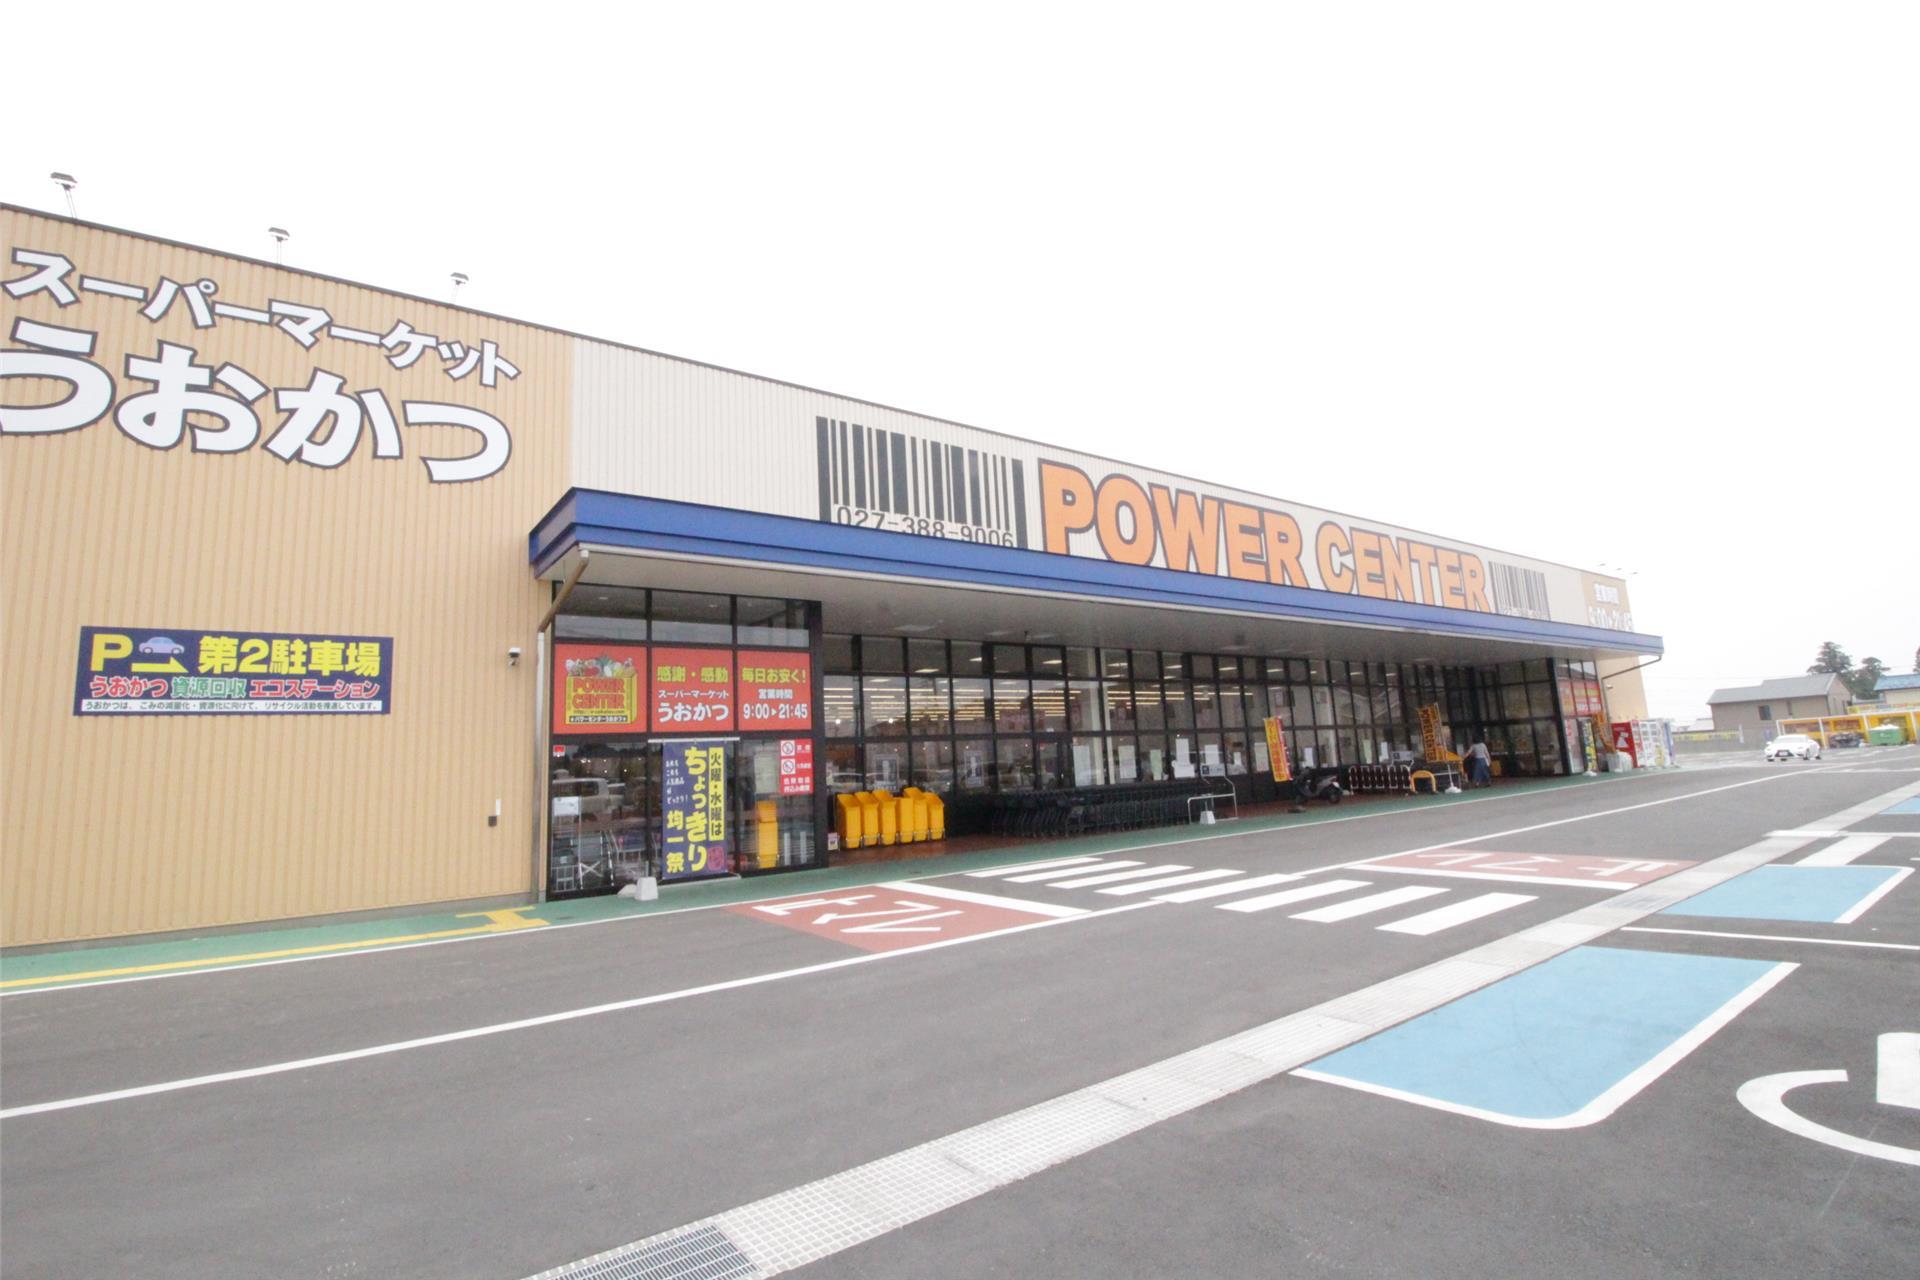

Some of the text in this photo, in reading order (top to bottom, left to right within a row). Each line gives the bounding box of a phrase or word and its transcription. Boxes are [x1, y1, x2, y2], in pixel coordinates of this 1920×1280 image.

[2, 246, 521, 387] スーパーマーケット
[0, 316, 512, 483] うおかつ
[837, 506, 1014, 547] 027-388-9006
[1038, 458, 1491, 613] POWER CENTER
[90, 634, 381, 677] P 第2駐車場
[657, 666, 729, 683] 感謝・感動
[90, 675, 381, 699] うおかつ 資源回収 エコステーション
[658, 689, 729, 699] スーパーマーケット
[758, 688, 793, 699] 営業時間
[658, 702, 729, 723] うおかつ
[684, 746, 708, 872] ちょっきり
[710, 752, 722, 837] 火曜・水曜は
[666, 810, 684, 873] 均一祭
